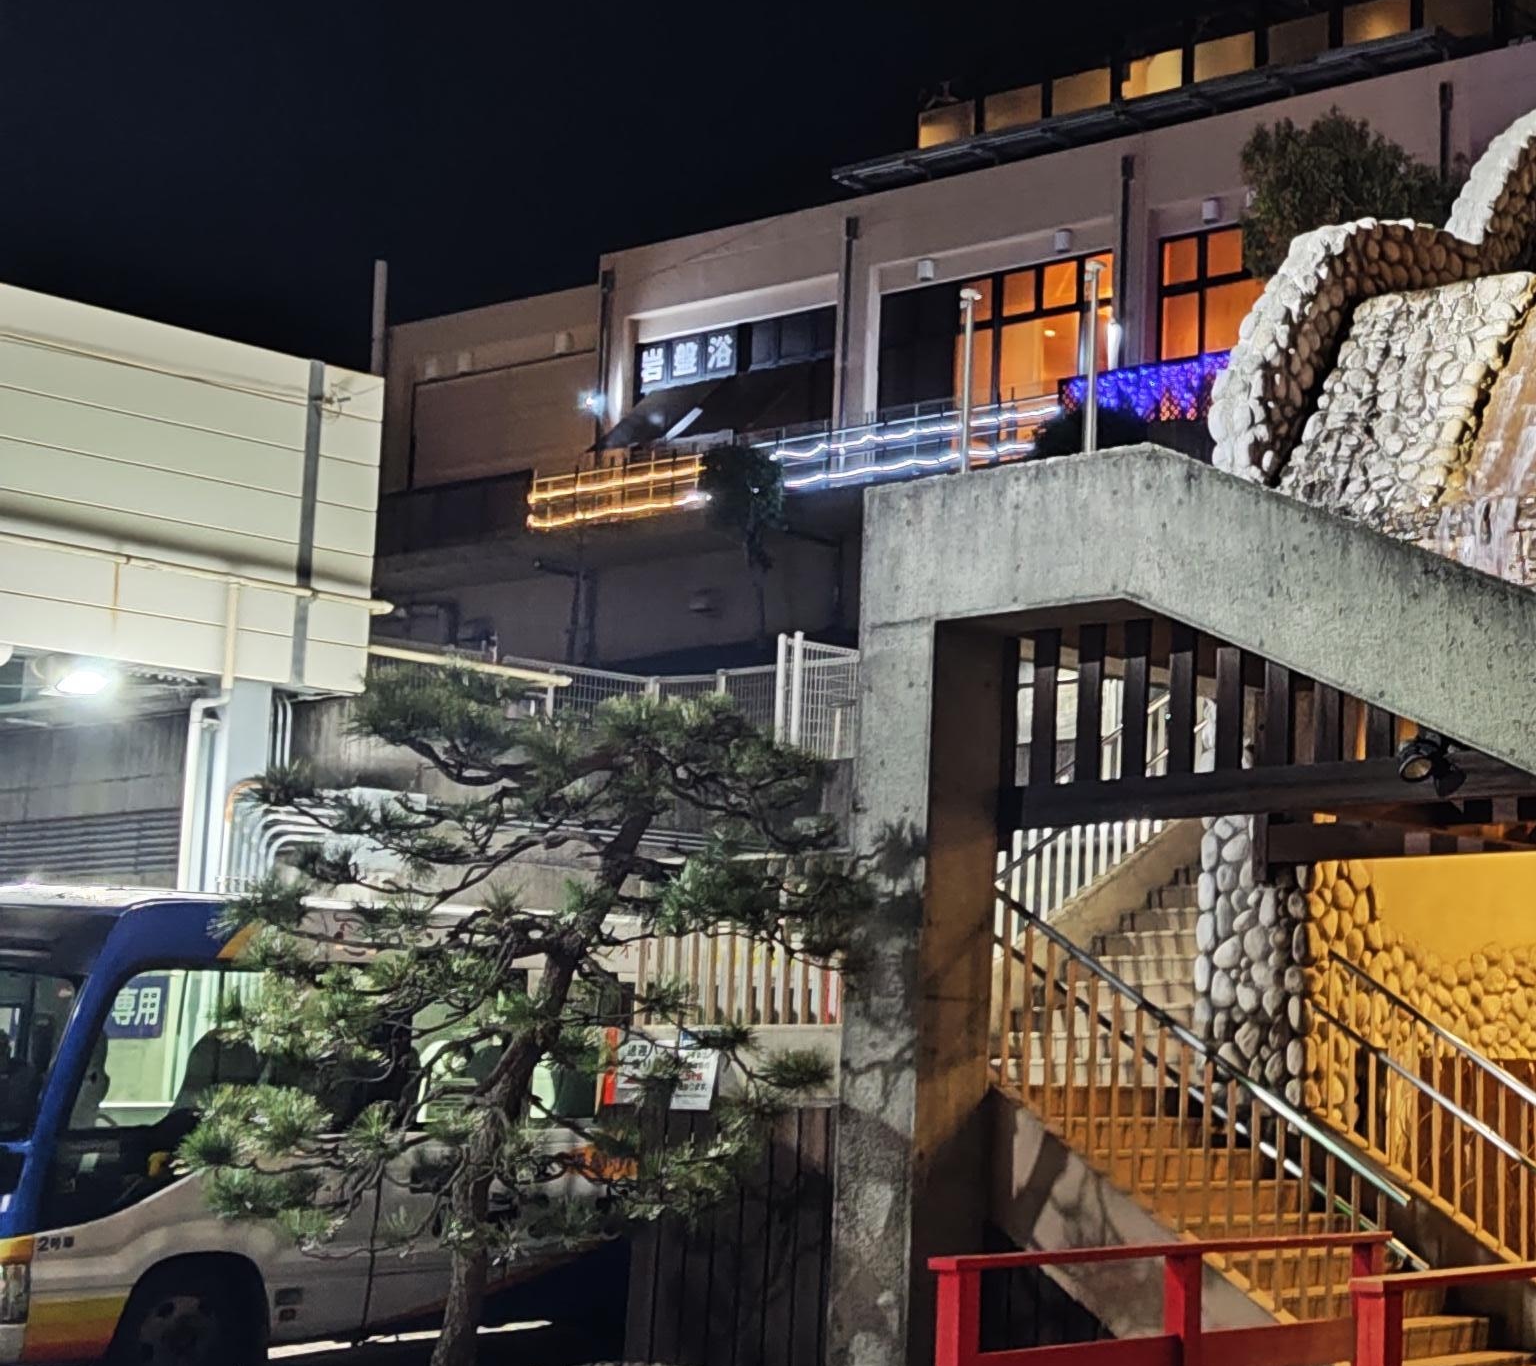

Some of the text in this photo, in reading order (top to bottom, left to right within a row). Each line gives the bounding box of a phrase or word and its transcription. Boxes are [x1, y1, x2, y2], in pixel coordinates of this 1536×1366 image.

[641, 334, 733, 383] 岩盤浴
[112, 986, 162, 1026] 専用
